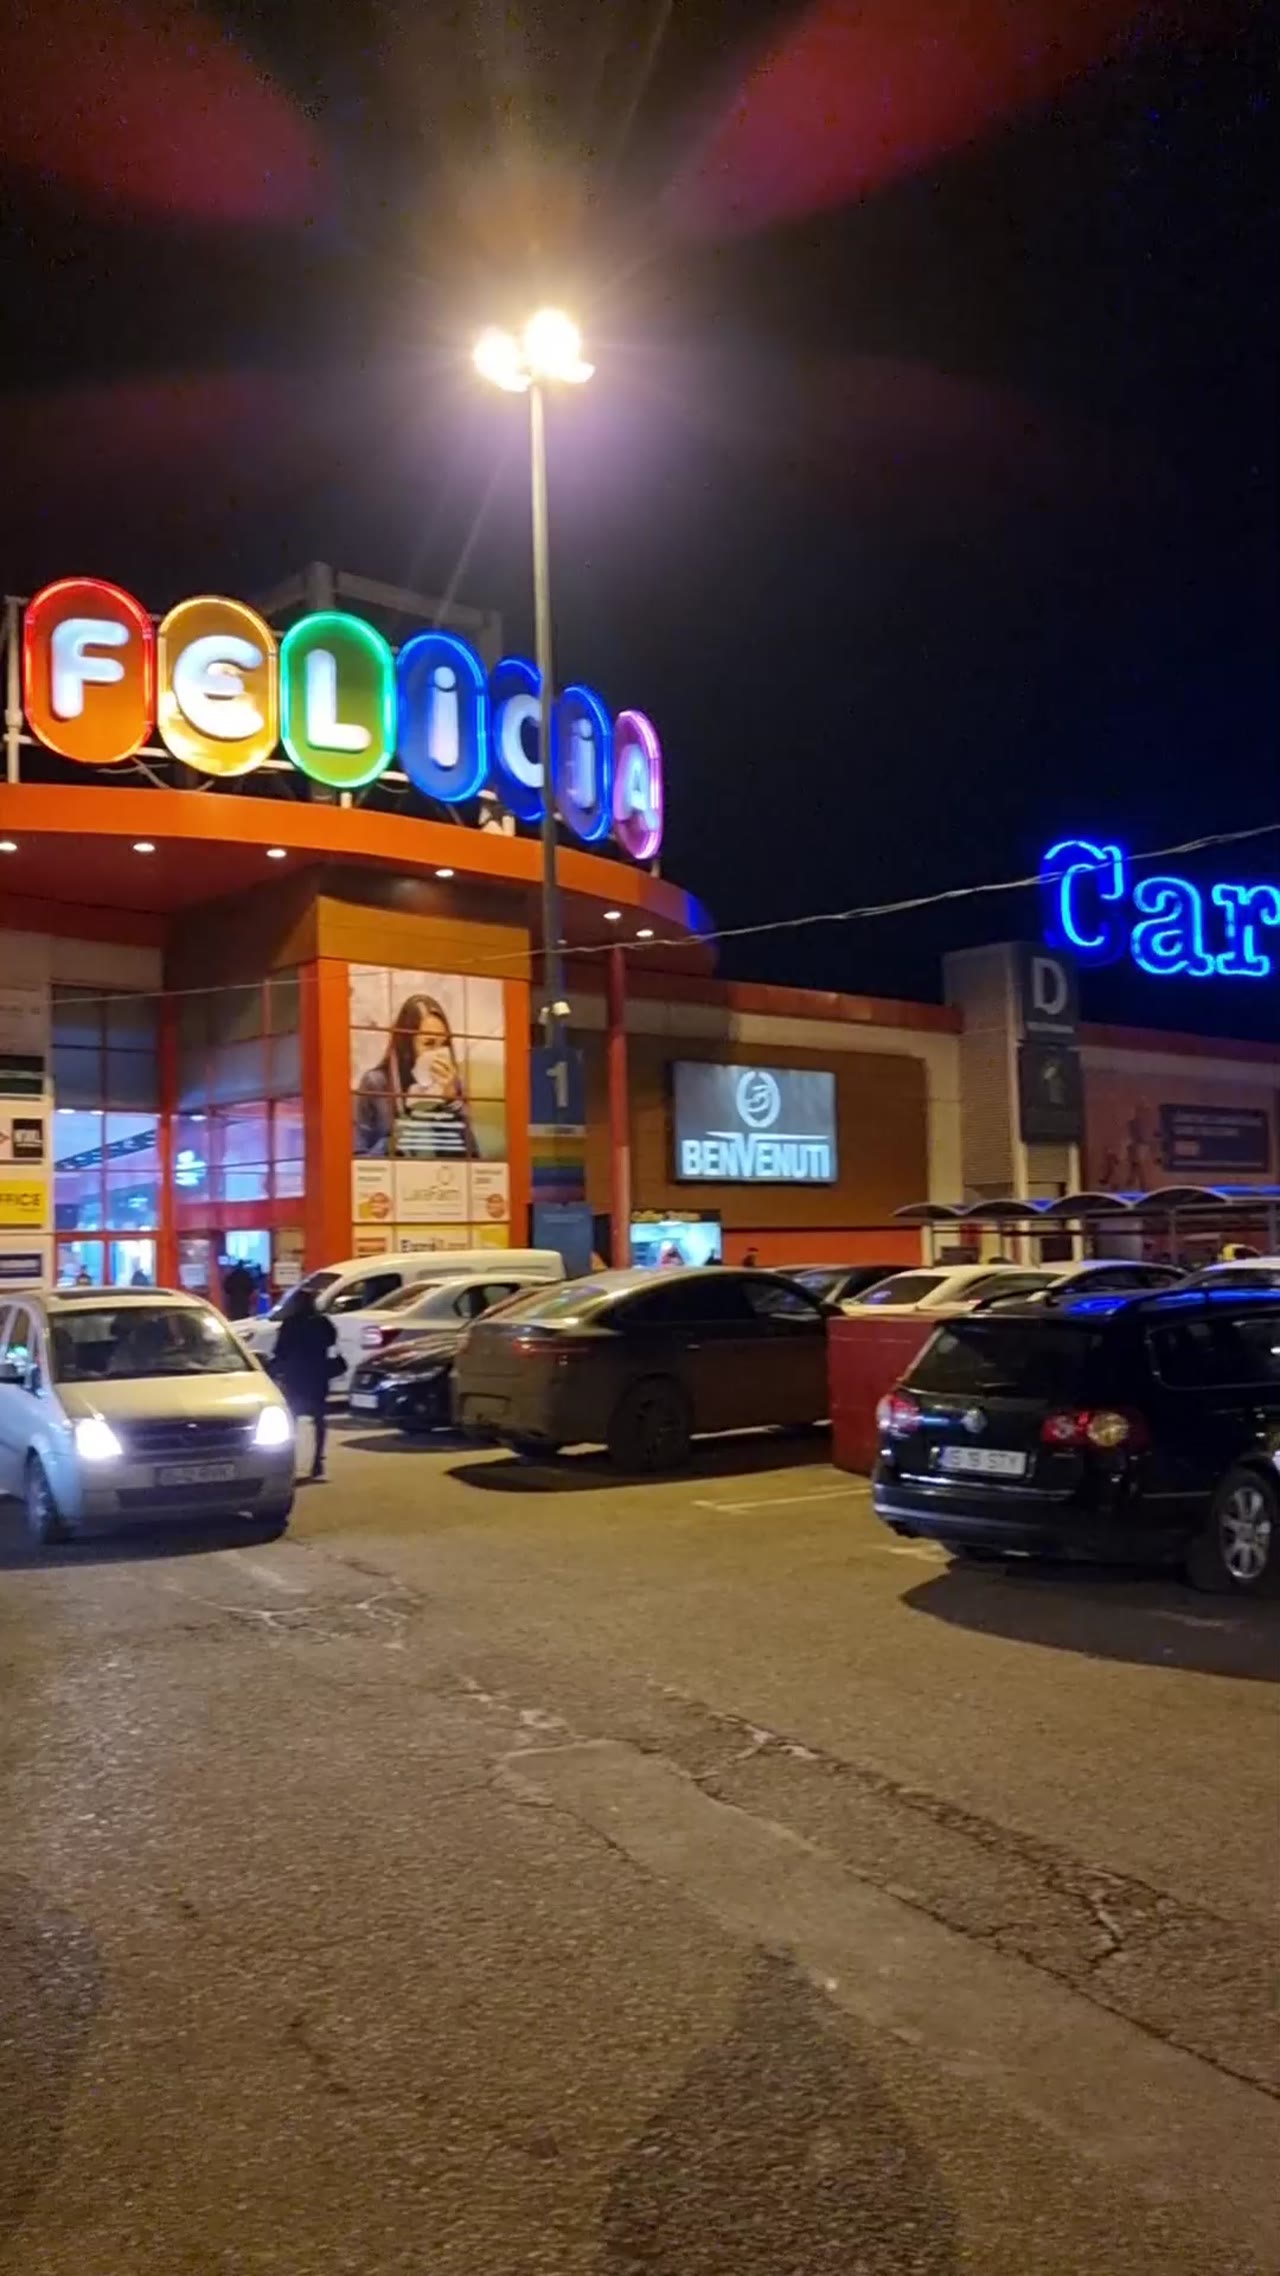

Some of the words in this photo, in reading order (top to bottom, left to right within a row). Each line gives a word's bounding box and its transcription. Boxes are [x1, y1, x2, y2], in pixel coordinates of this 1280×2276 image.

[1043, 839, 1280, 977] Car
[1032, 956, 1068, 1016] D
[546, 1060, 568, 1108] 1
[681, 1130, 831, 1179] BENVENUTI
